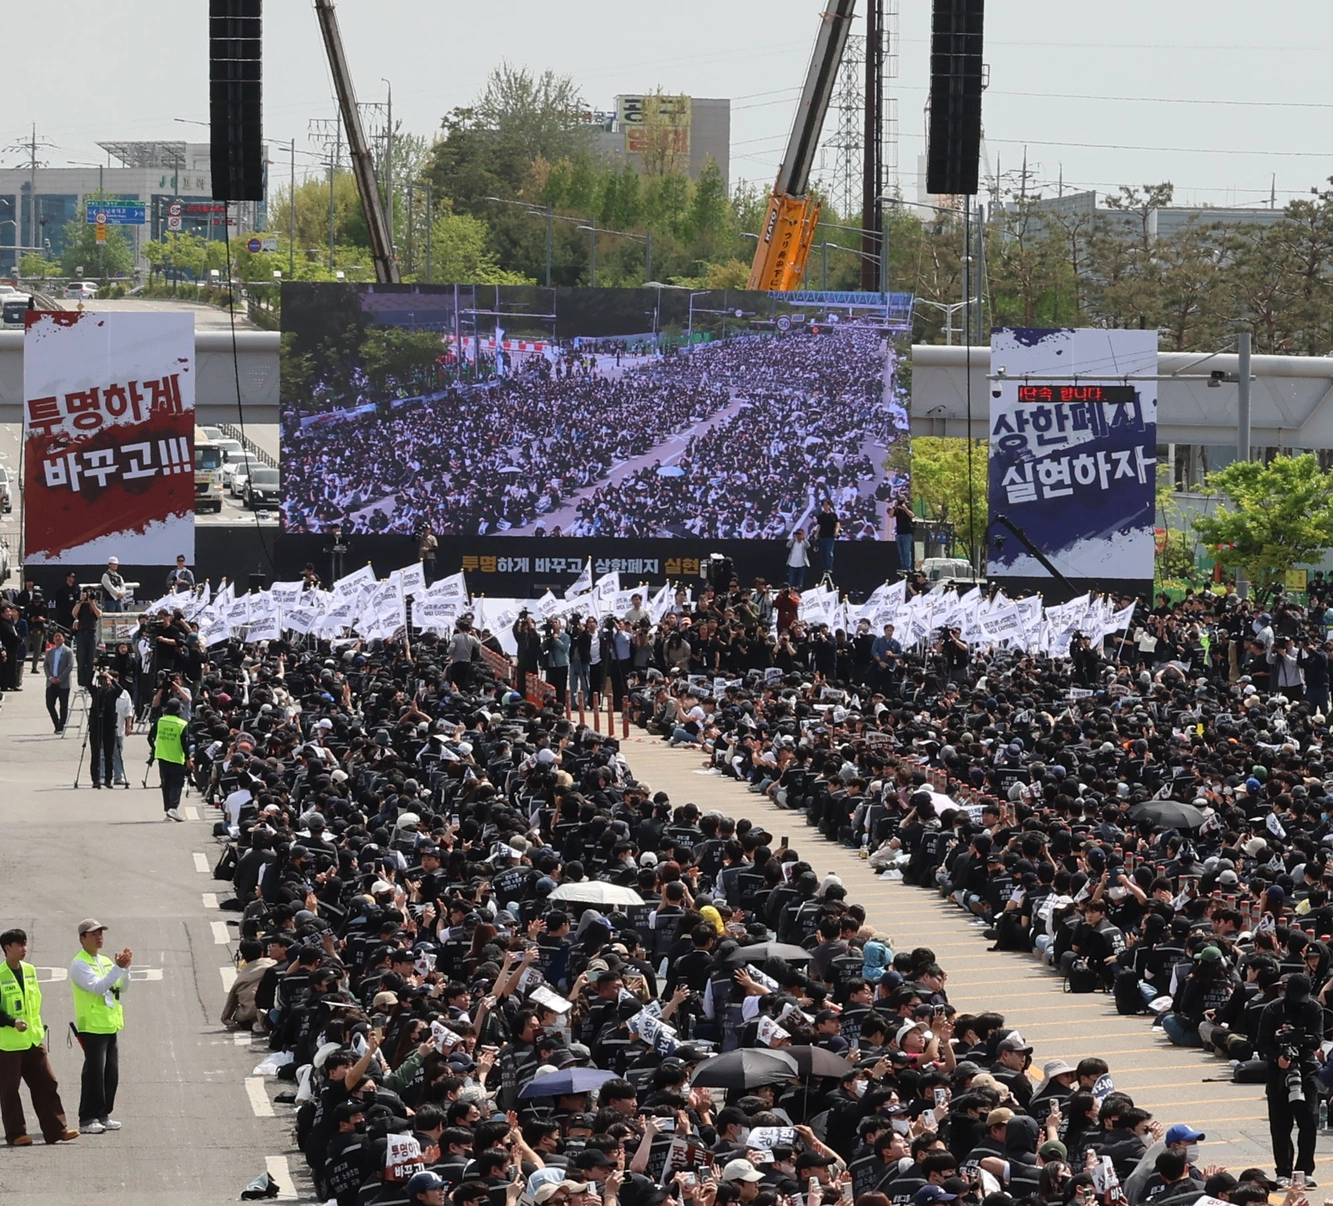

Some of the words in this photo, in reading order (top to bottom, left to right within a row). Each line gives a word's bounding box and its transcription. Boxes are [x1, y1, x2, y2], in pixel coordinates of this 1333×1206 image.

[764, 208, 778, 244] KATO
[27, 373, 183, 434] 투명하게
[992, 392, 1147, 450] 상한폐지
[43, 436, 192, 492] 바꾸고!!!
[1001, 445, 1157, 503] 실현하자
[462, 555, 530, 573] 투명하게
[595, 557, 659, 574] 상한폐지
[391, 1144, 421, 1158] 투명하
